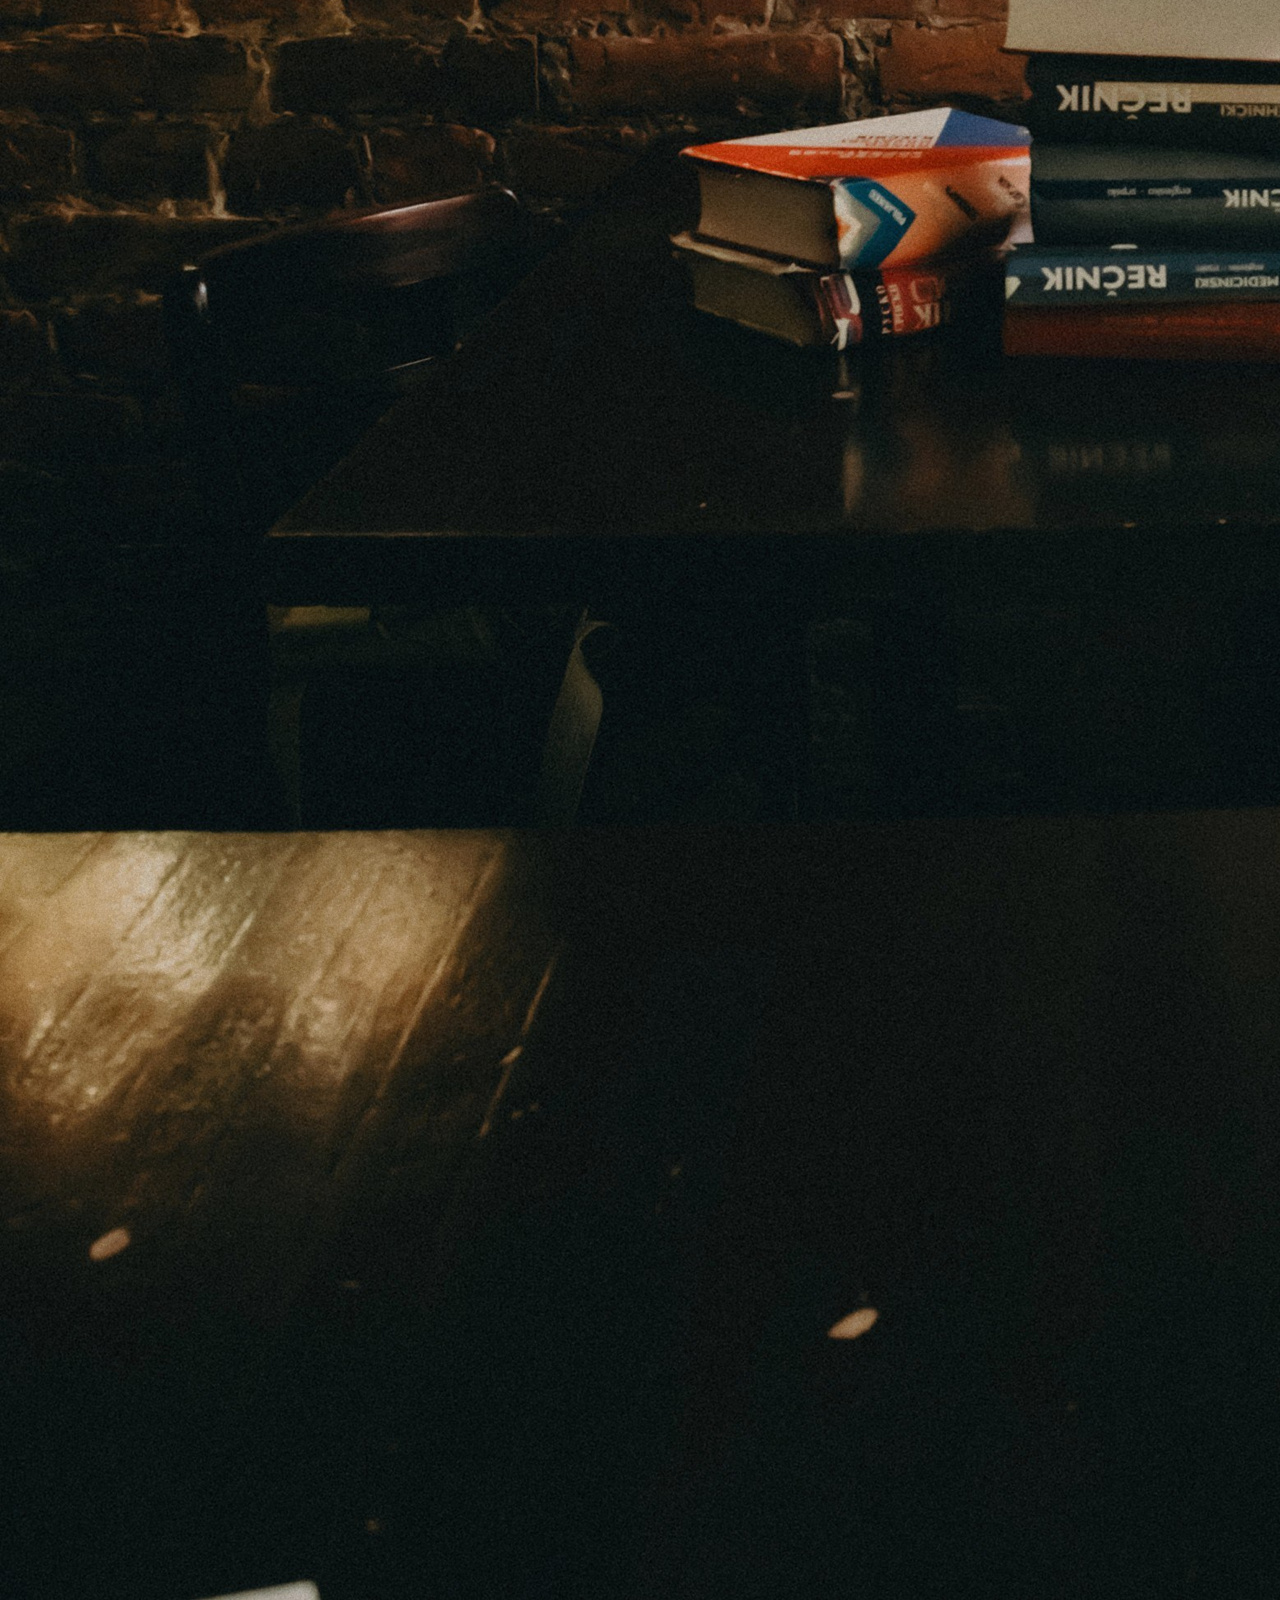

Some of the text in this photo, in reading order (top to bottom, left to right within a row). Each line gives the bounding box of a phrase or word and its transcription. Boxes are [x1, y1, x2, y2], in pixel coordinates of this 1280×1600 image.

[1056, 83, 1193, 121] REČNIK
[1041, 265, 1280, 297] MEDICINSKI REČNIK
